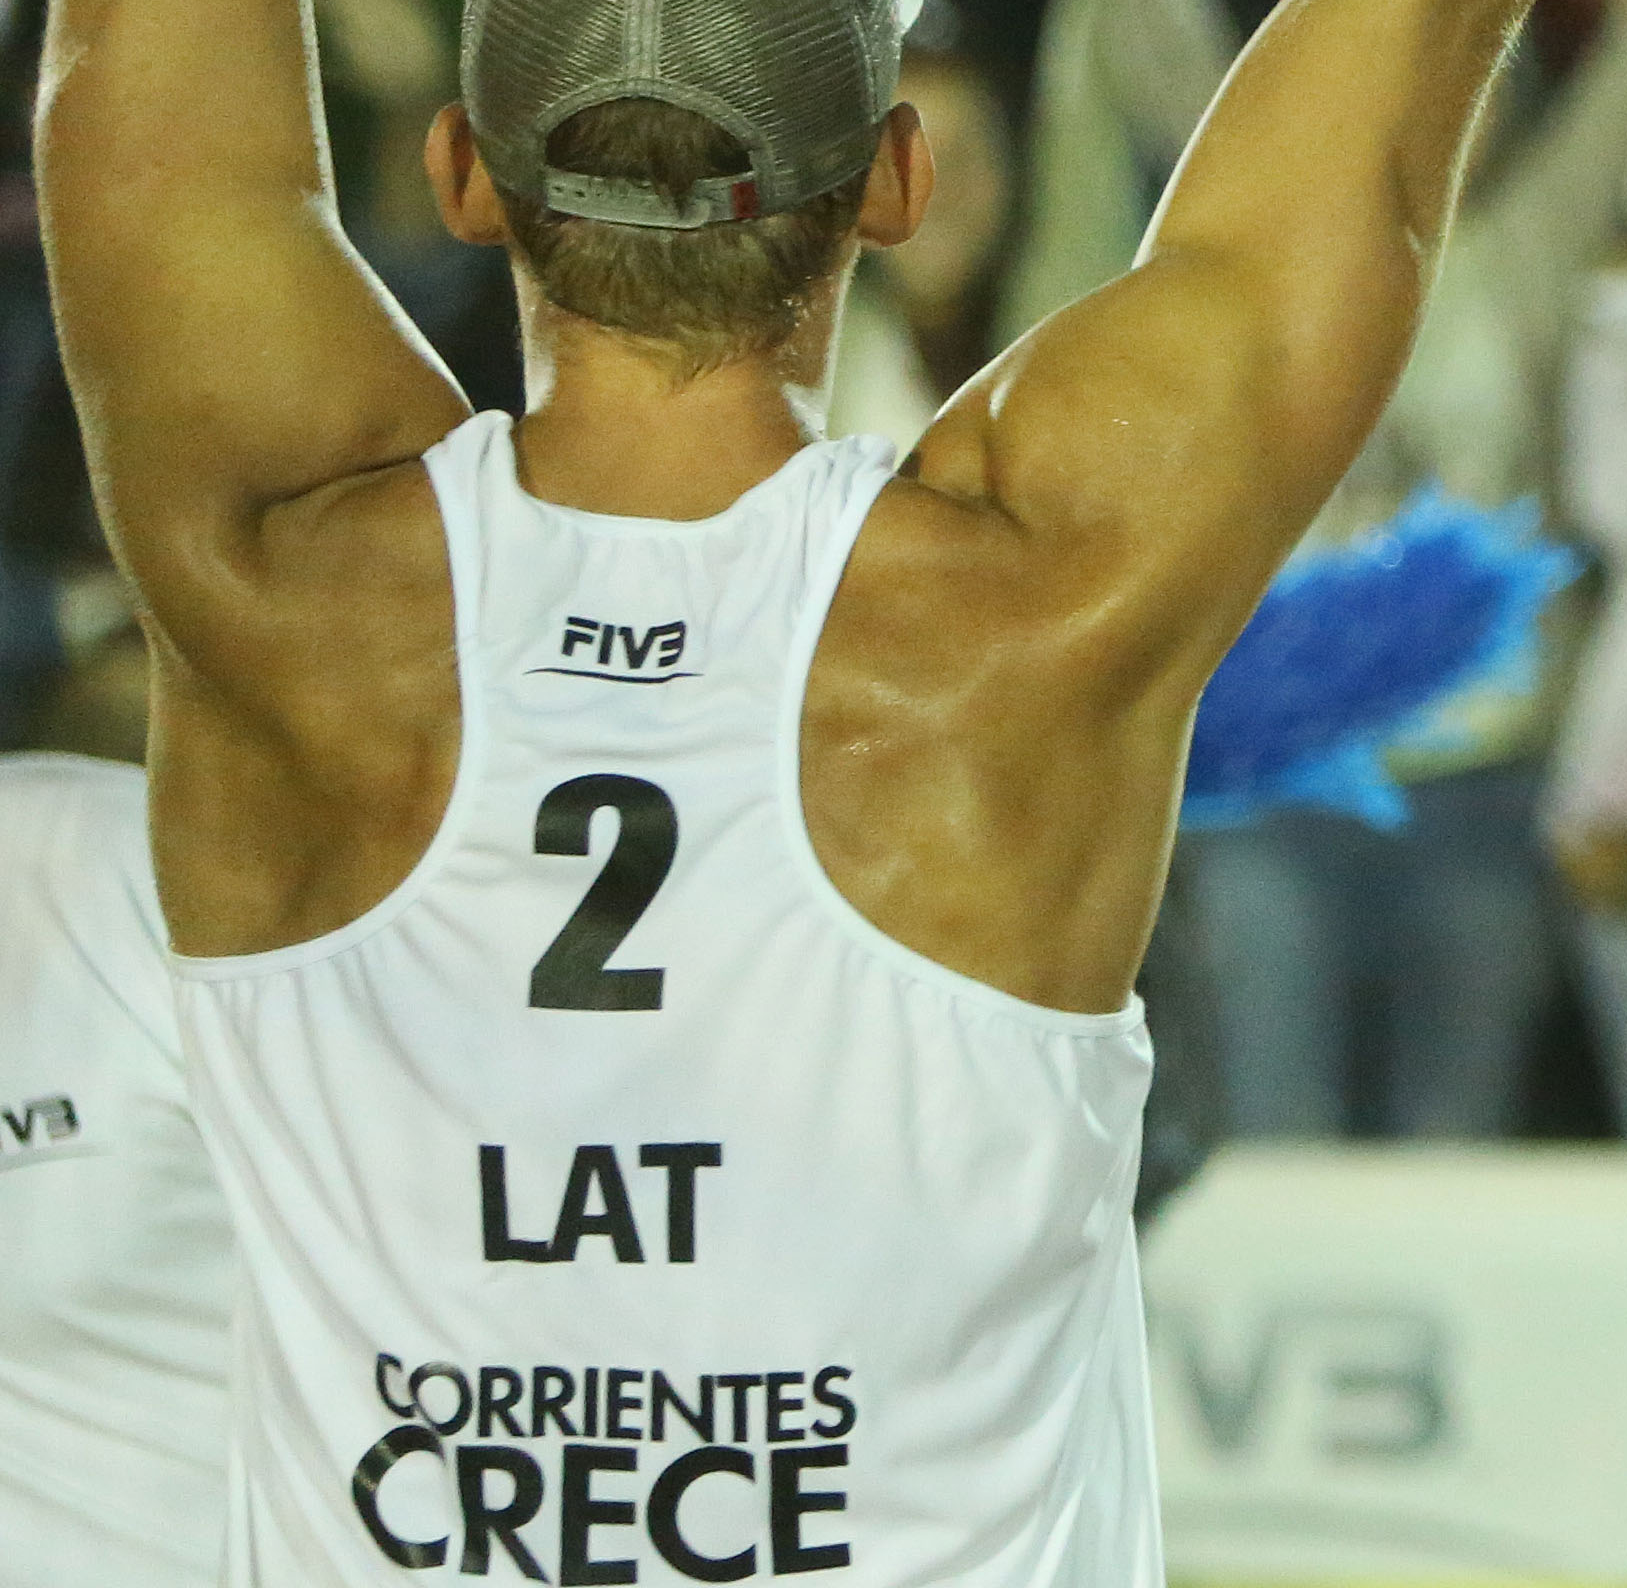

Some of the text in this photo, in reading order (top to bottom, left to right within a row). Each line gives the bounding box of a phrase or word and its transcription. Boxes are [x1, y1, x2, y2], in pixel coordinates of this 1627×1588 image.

[528, 773, 679, 1012] 2
[478, 1142, 722, 1264] LAT
[375, 1352, 858, 1443] CORRIENTES
[352, 1424, 851, 1587] CRECE
